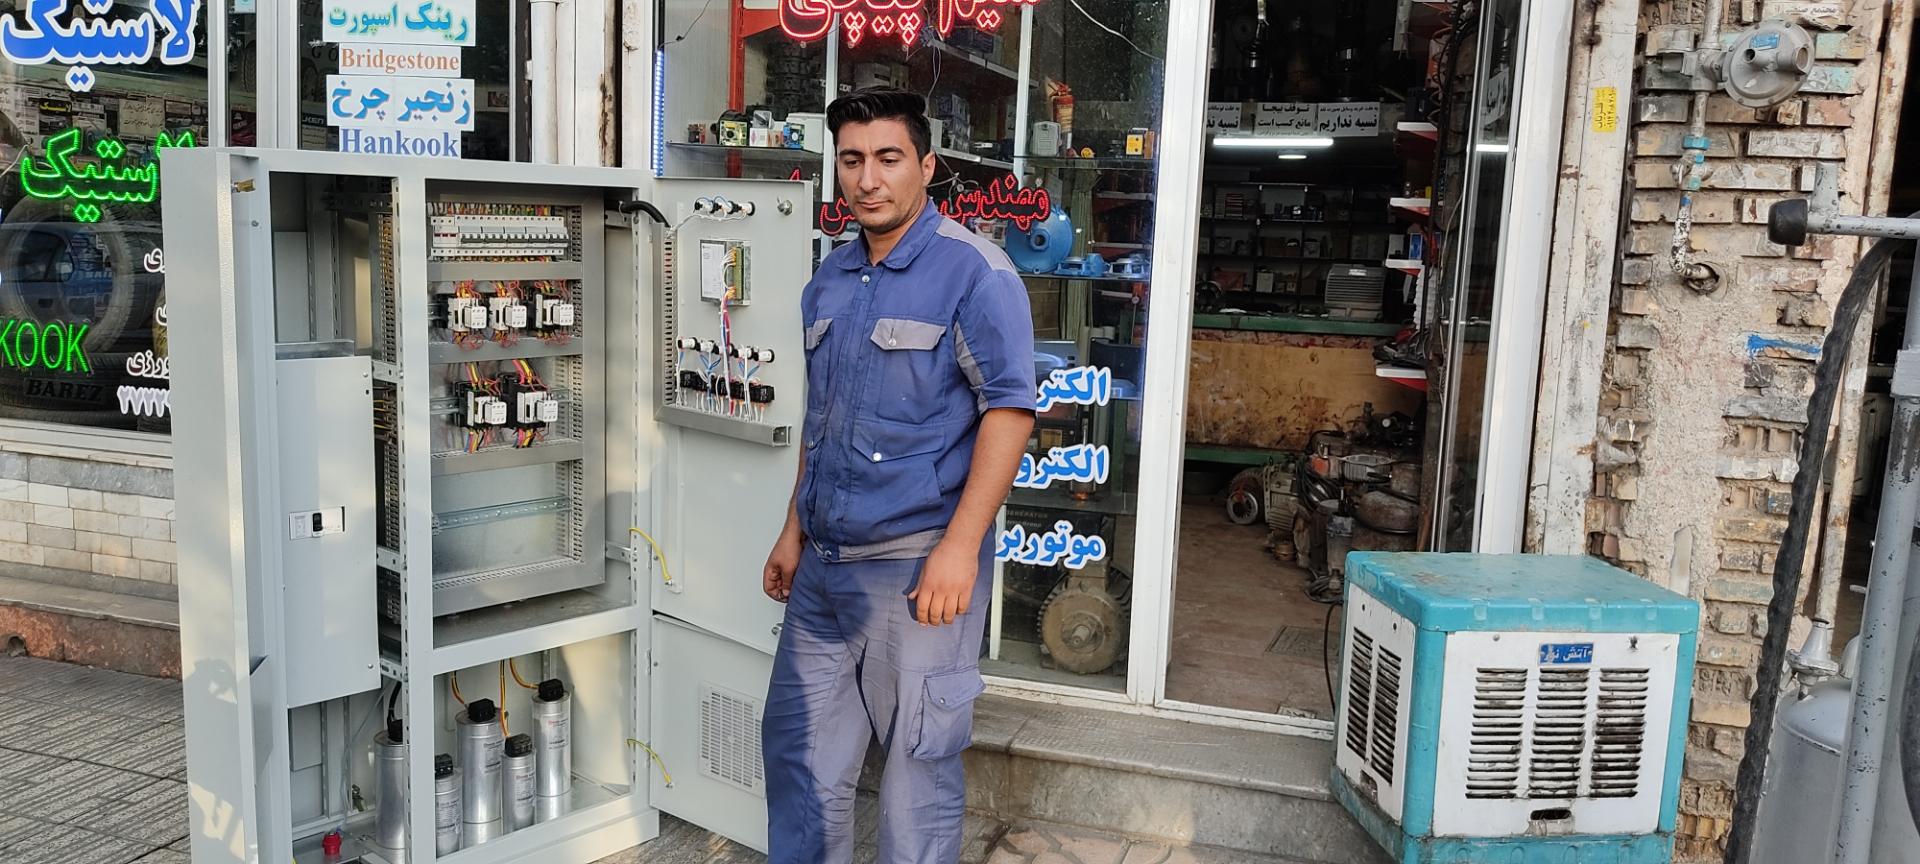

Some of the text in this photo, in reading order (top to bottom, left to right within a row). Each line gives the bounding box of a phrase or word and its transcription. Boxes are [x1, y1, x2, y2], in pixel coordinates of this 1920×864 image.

[329, 4, 399, 35] اسپورت
[341, 48, 460, 75] Bridgestone
[331, 80, 471, 125] زنجیر چرخ
[1320, 114, 1377, 132] نسیه نداریم
[341, 128, 459, 157] Hankook
[26, 379, 104, 401] BAREZ
[1563, 645, 1588, 662] آتش
